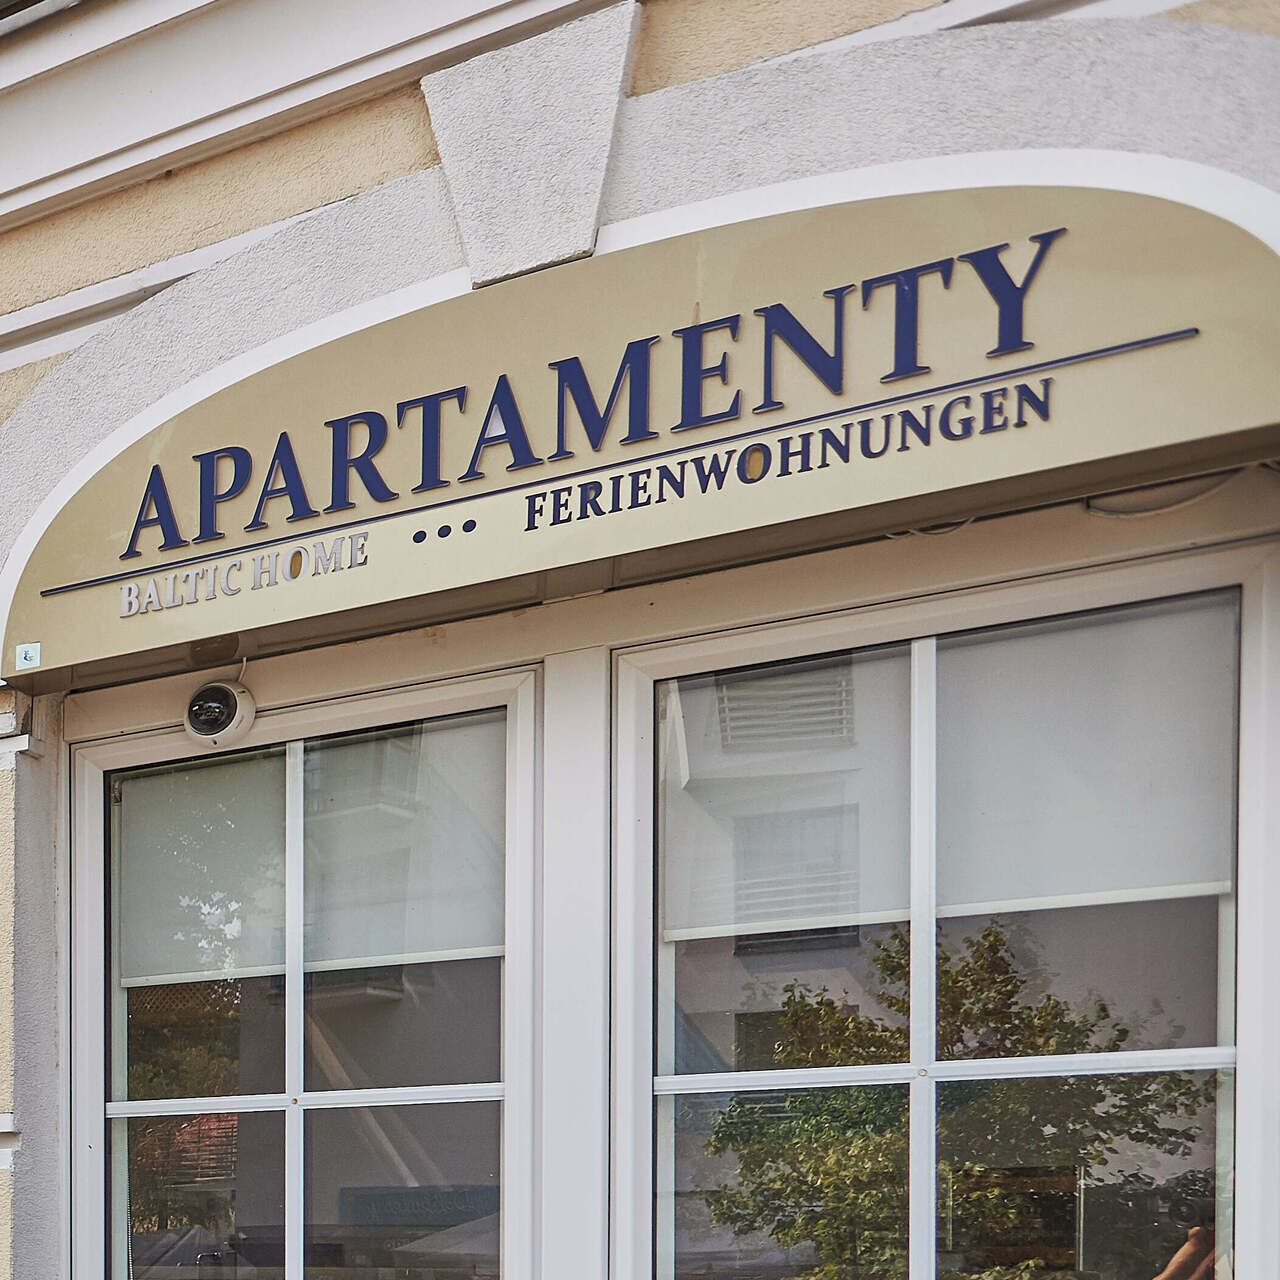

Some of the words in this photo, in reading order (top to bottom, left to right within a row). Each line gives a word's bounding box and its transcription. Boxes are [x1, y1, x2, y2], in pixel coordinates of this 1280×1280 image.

[118, 224, 1070, 561] APARTAMENTY
[523, 377, 1056, 532] FERIENWOHNUNGEN
[119, 558, 242, 619] BALTIC
[251, 531, 370, 591] HOME
